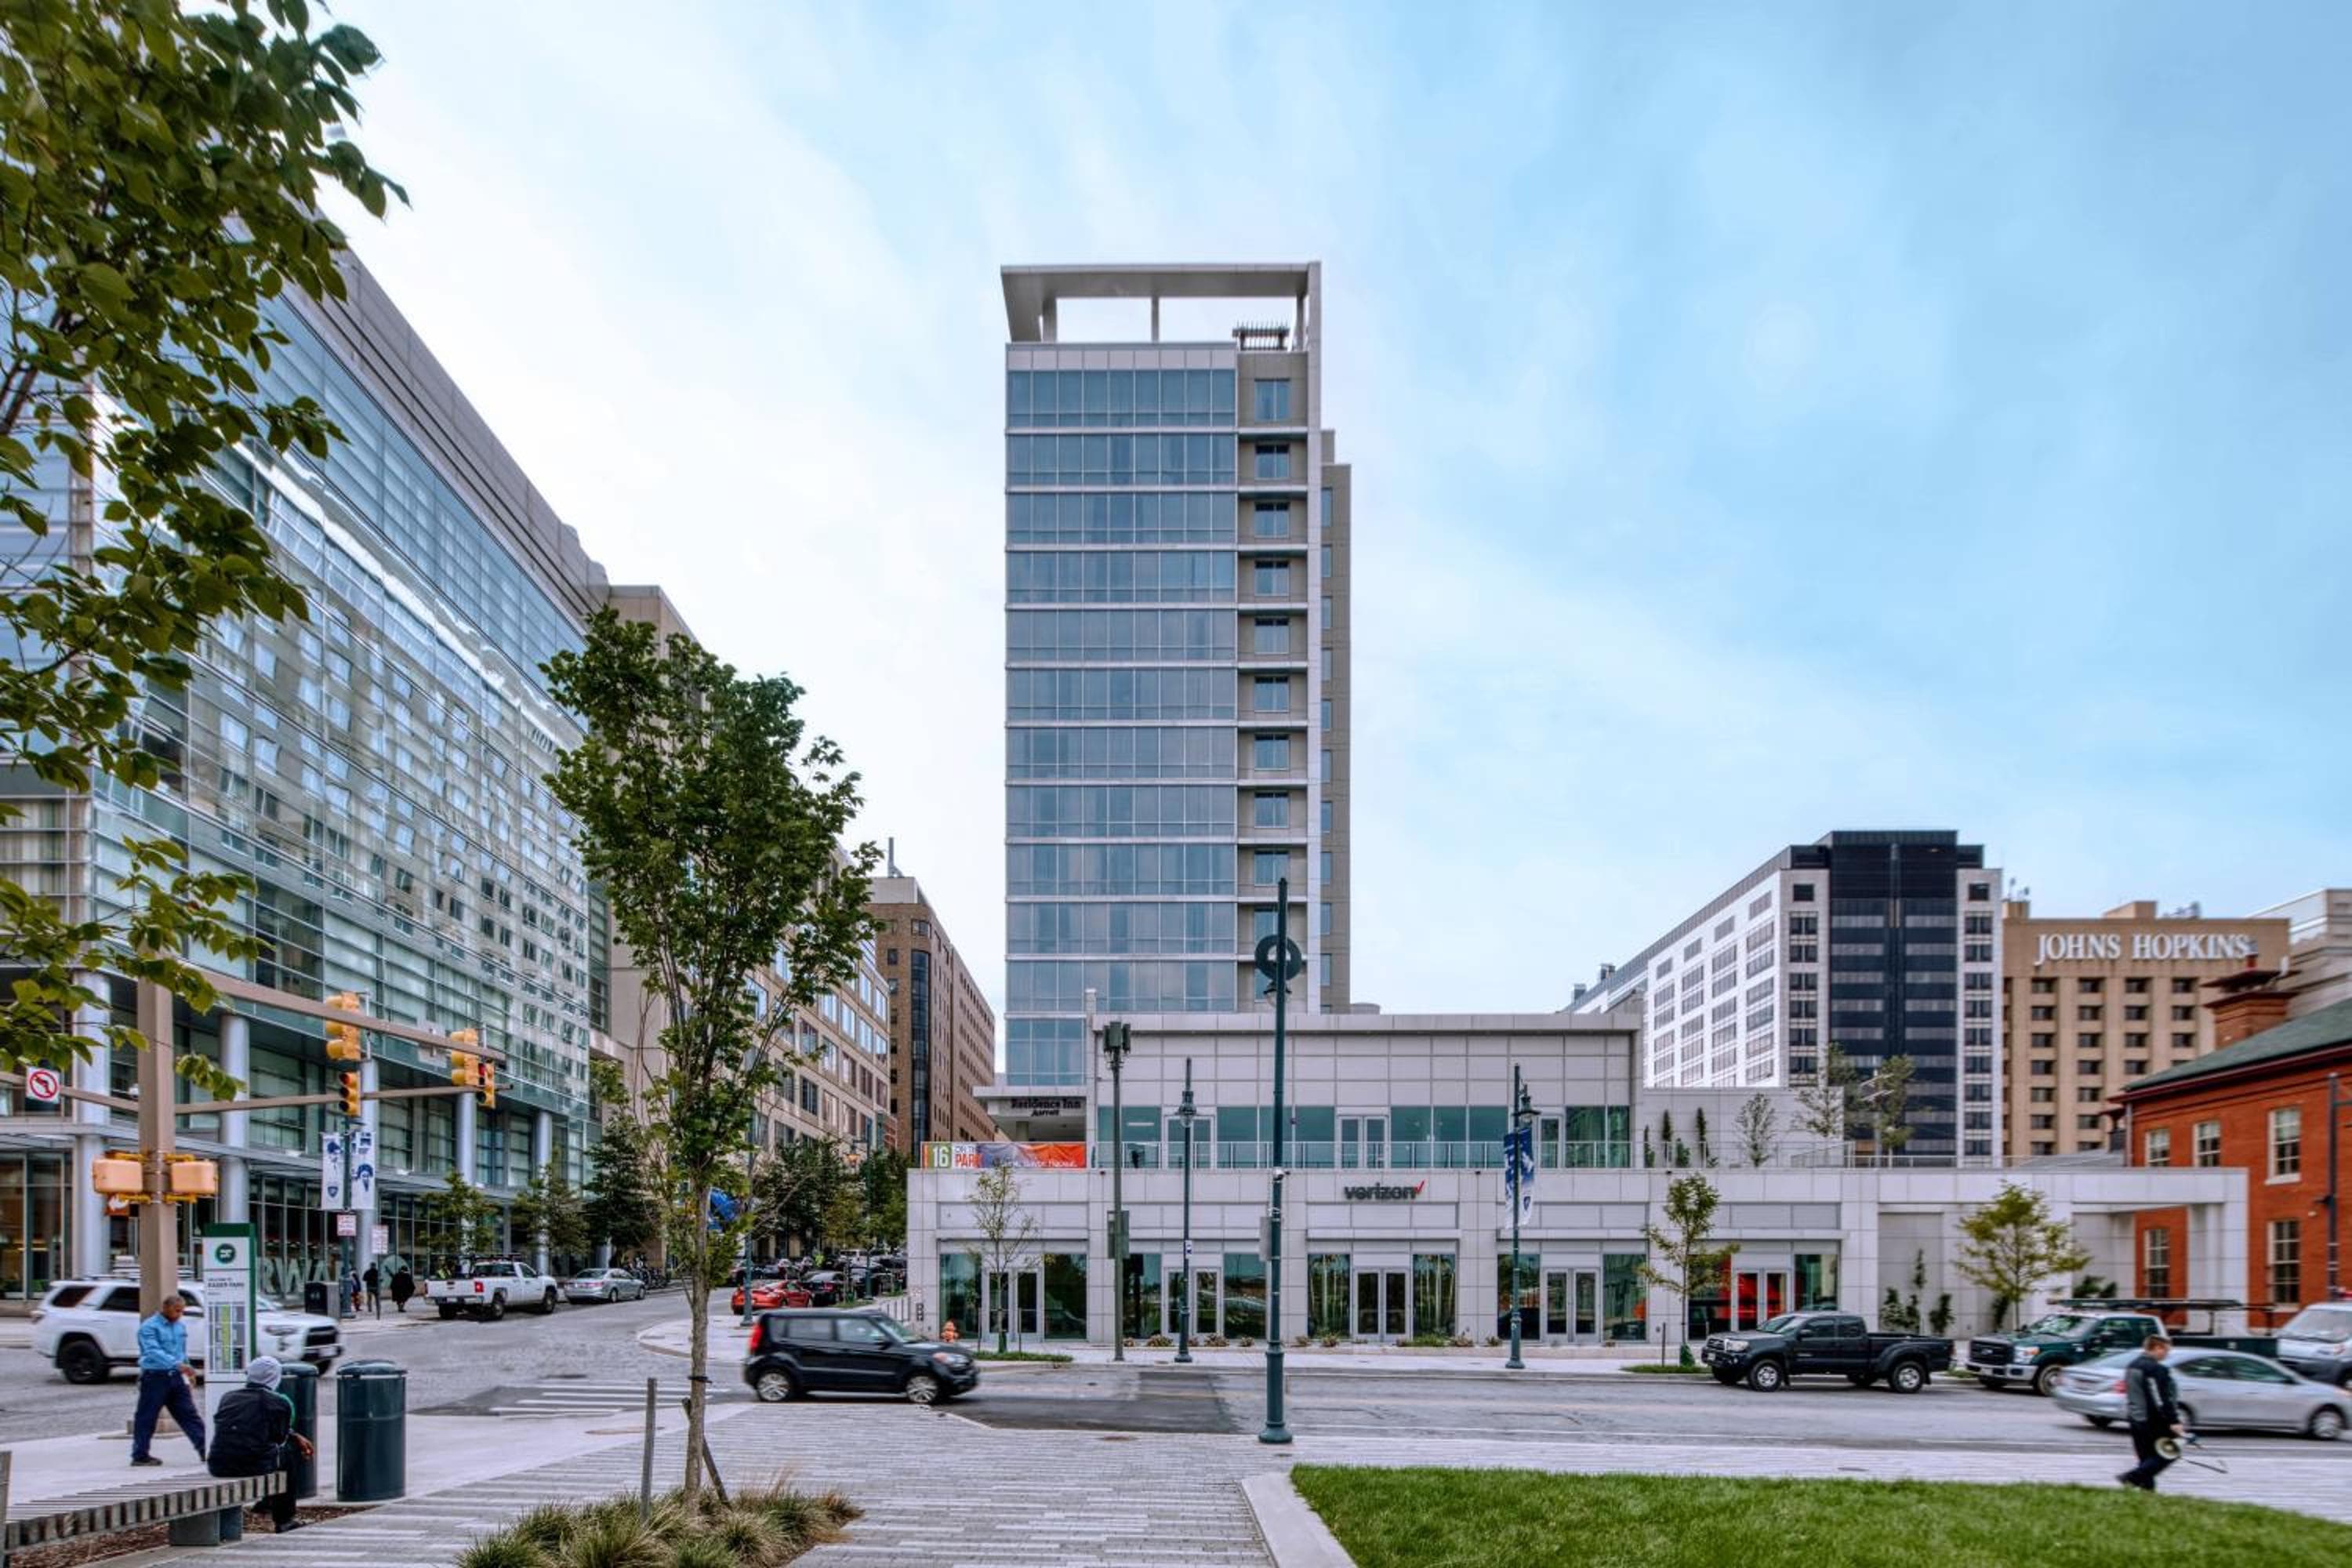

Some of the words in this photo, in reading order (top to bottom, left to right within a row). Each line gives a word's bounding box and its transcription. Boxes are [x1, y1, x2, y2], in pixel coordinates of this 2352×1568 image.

[2034, 933, 2121, 966] JOHNS
[2132, 934, 2252, 960] HOPKINS
[933, 1145, 950, 1167] 16
[1344, 1181, 1416, 1200] verizon
